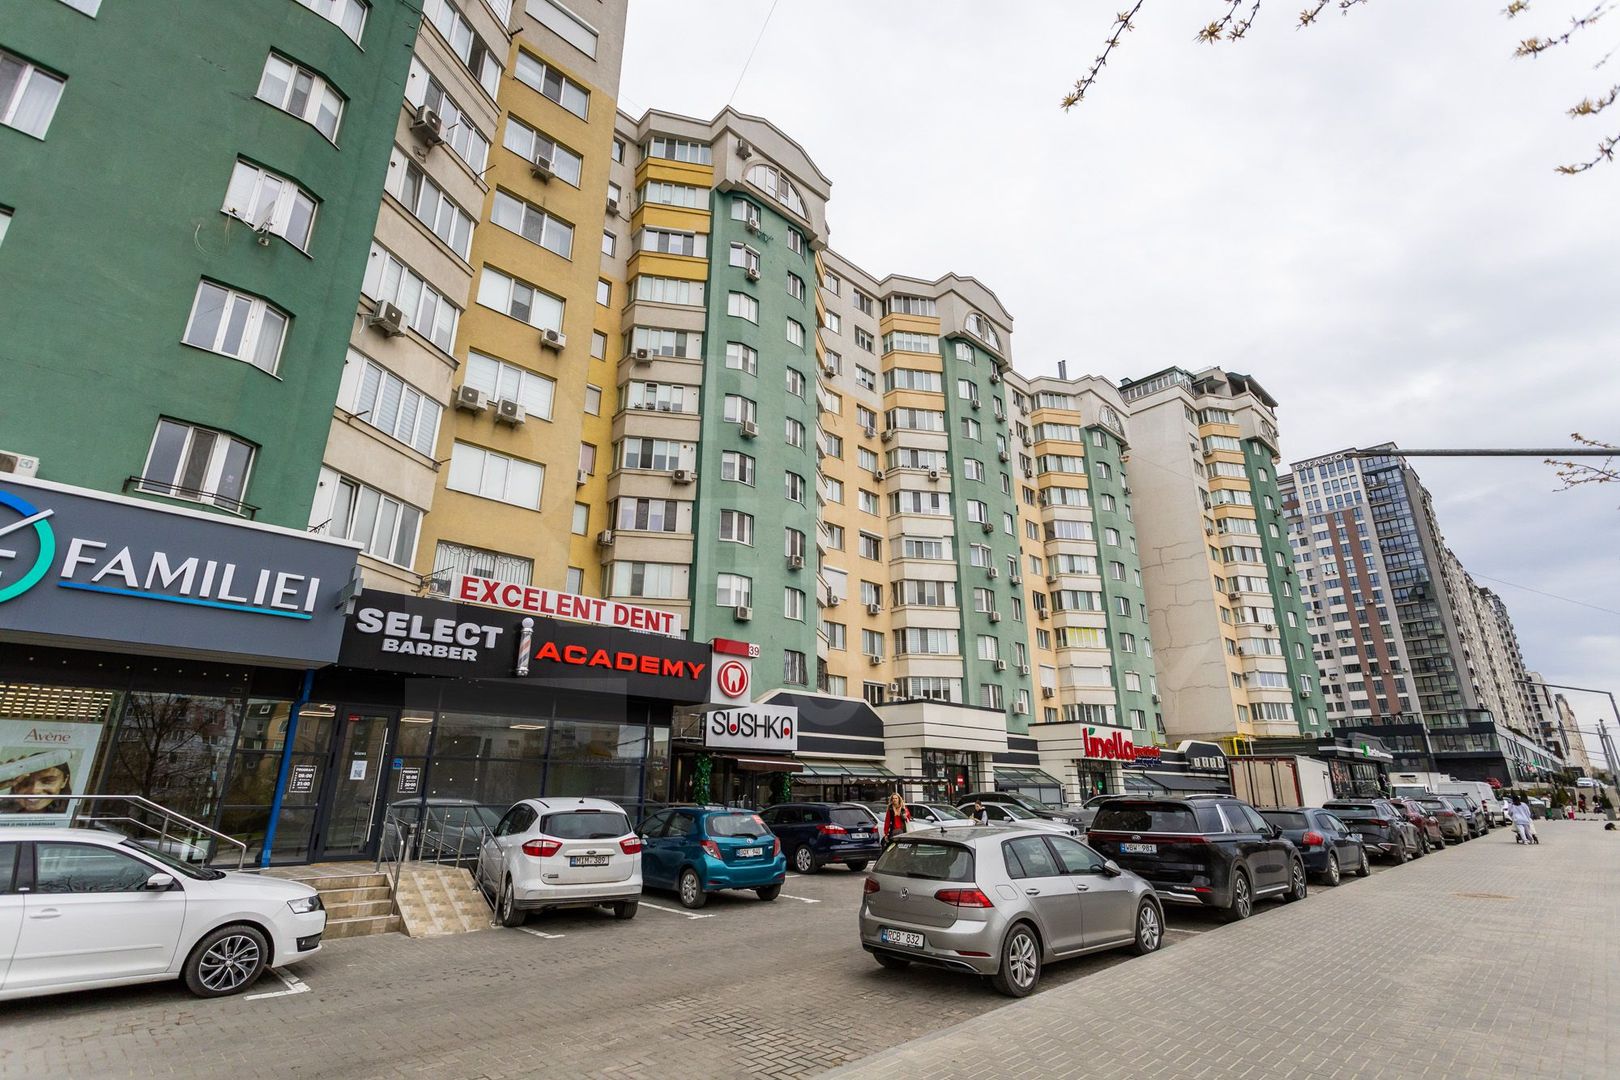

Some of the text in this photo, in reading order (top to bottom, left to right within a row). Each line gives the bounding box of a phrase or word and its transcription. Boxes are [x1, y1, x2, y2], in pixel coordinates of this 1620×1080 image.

[1295, 453, 1343, 471] EXFACTO
[60, 537, 320, 613] FAMILIEI
[460, 575, 674, 634] EXCELENT DENT
[356, 607, 503, 648] SELECT
[381, 638, 477, 662] BARBER
[535, 641, 706, 681] ACADEMY
[749, 645, 760, 656] 39
[24, 728, 71, 742] Avène
[711, 710, 793, 740] SUSHKA
[906, 933, 920, 944] 832
